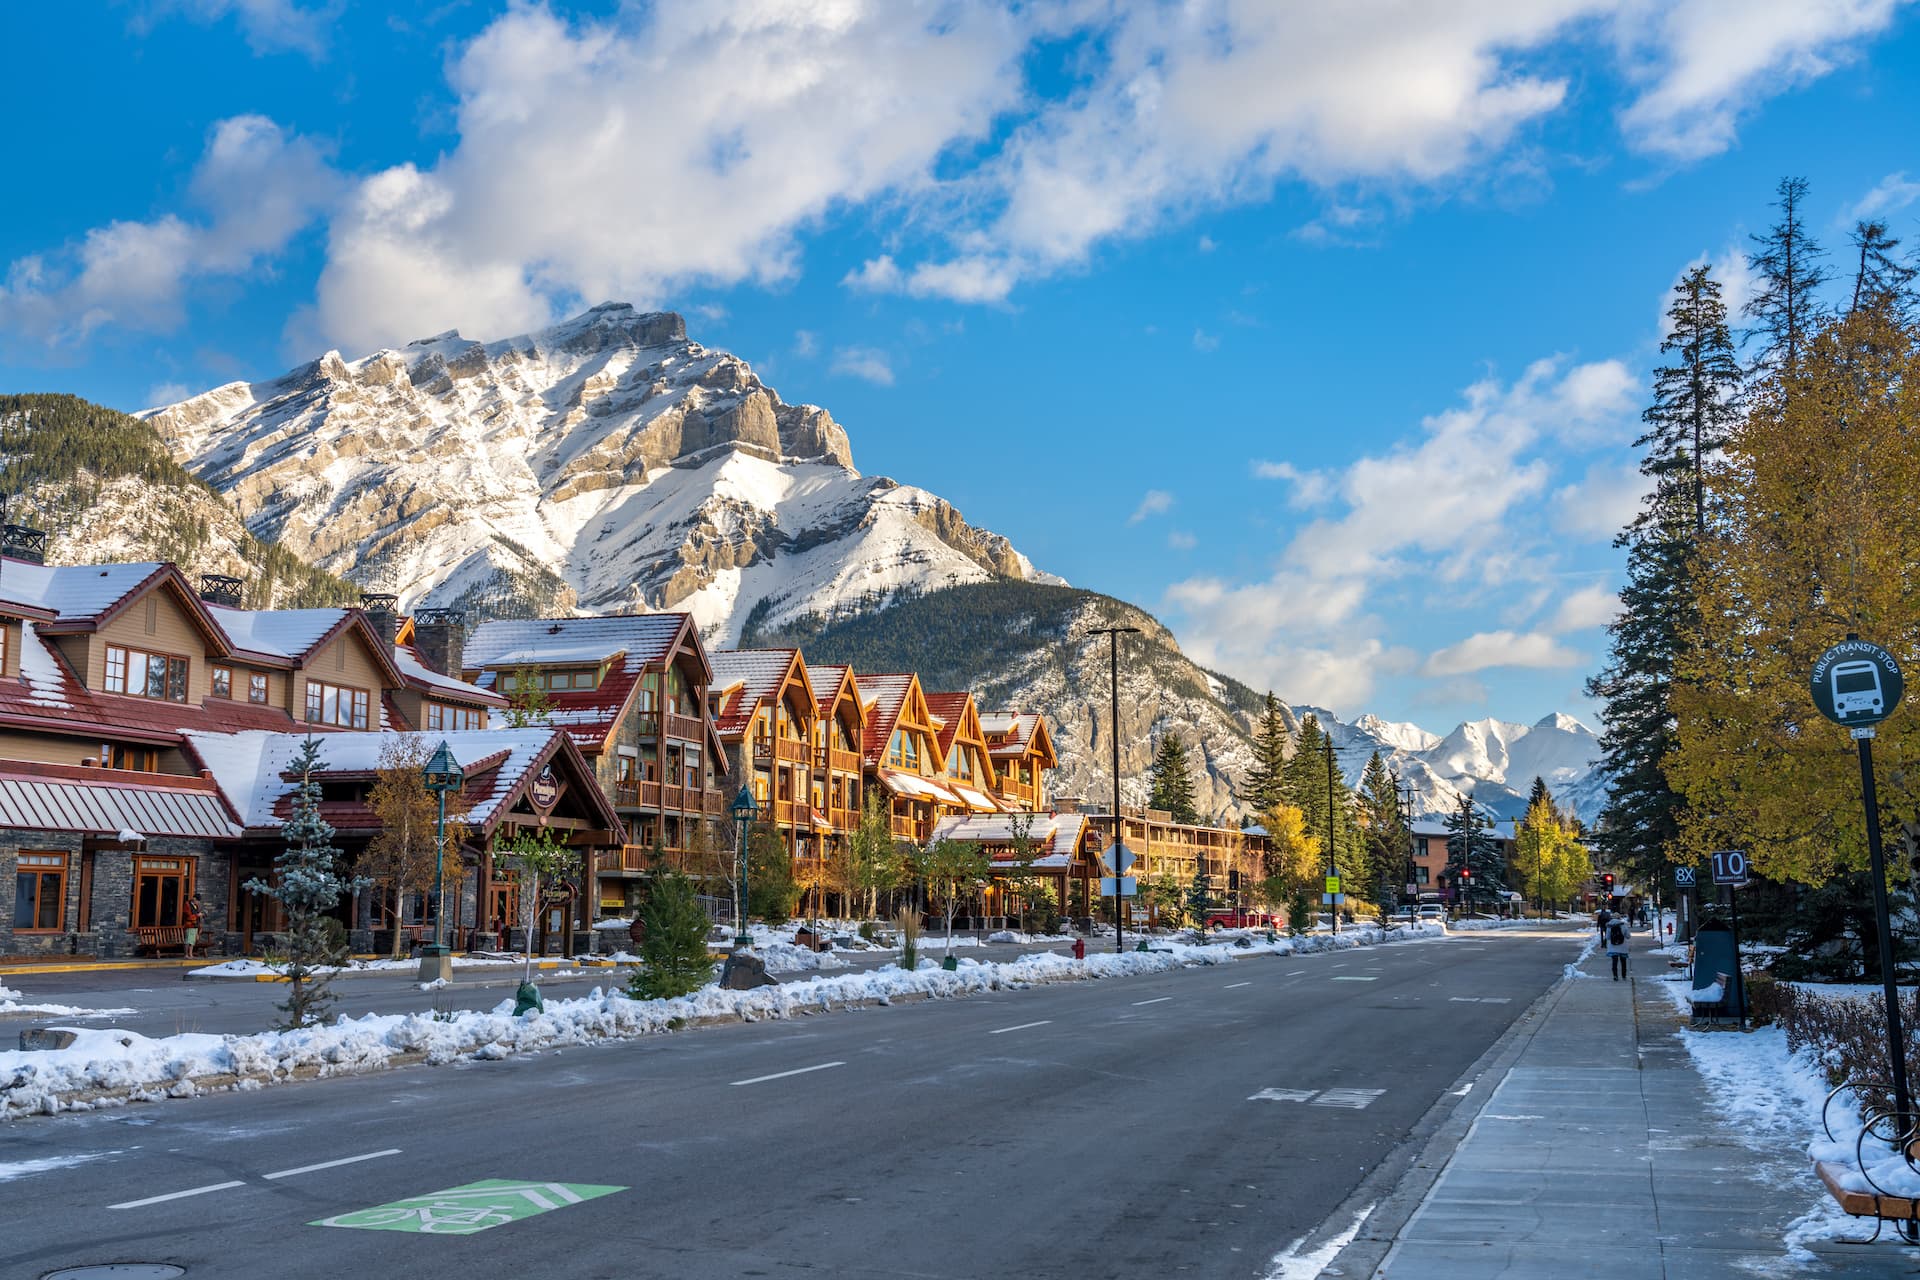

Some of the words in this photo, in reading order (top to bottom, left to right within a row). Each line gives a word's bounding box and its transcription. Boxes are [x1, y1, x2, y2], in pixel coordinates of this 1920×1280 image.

[1813, 651, 1835, 683] PUBLIC
[1833, 642, 1879, 655] TRANSIT
[1878, 651, 1898, 674] STOP
[1676, 868, 1695, 881] 8X
[1714, 852, 1744, 875] 10
